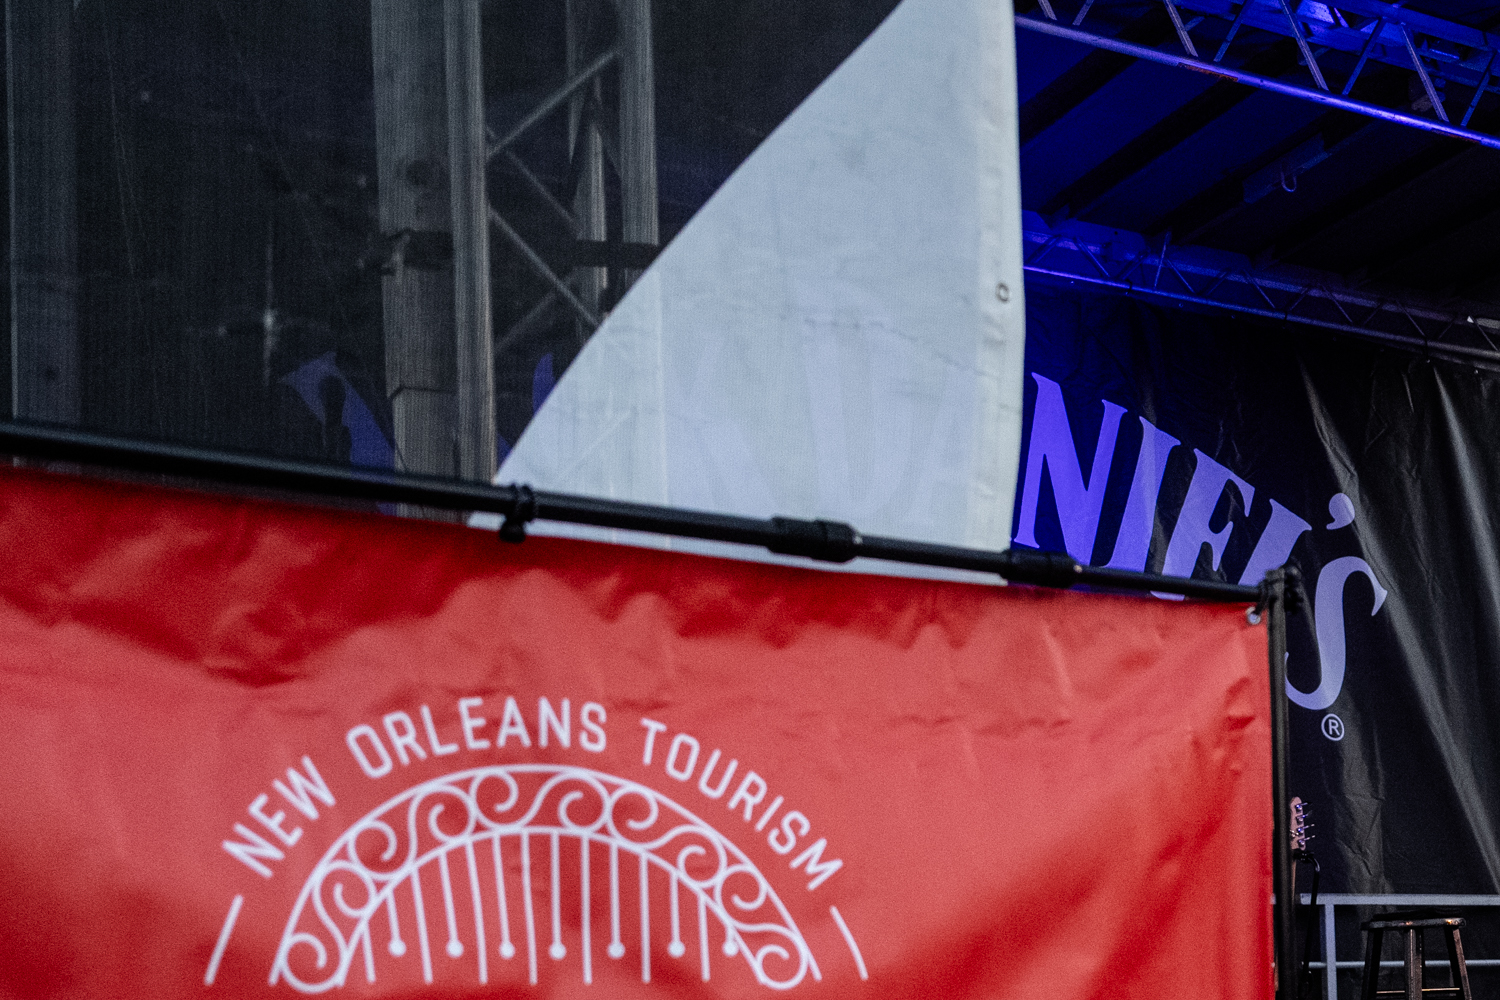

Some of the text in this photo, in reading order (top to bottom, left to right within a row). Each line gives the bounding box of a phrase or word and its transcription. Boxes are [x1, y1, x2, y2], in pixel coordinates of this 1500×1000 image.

[223, 695, 844, 890] NEW ORLEANS TOURISM
